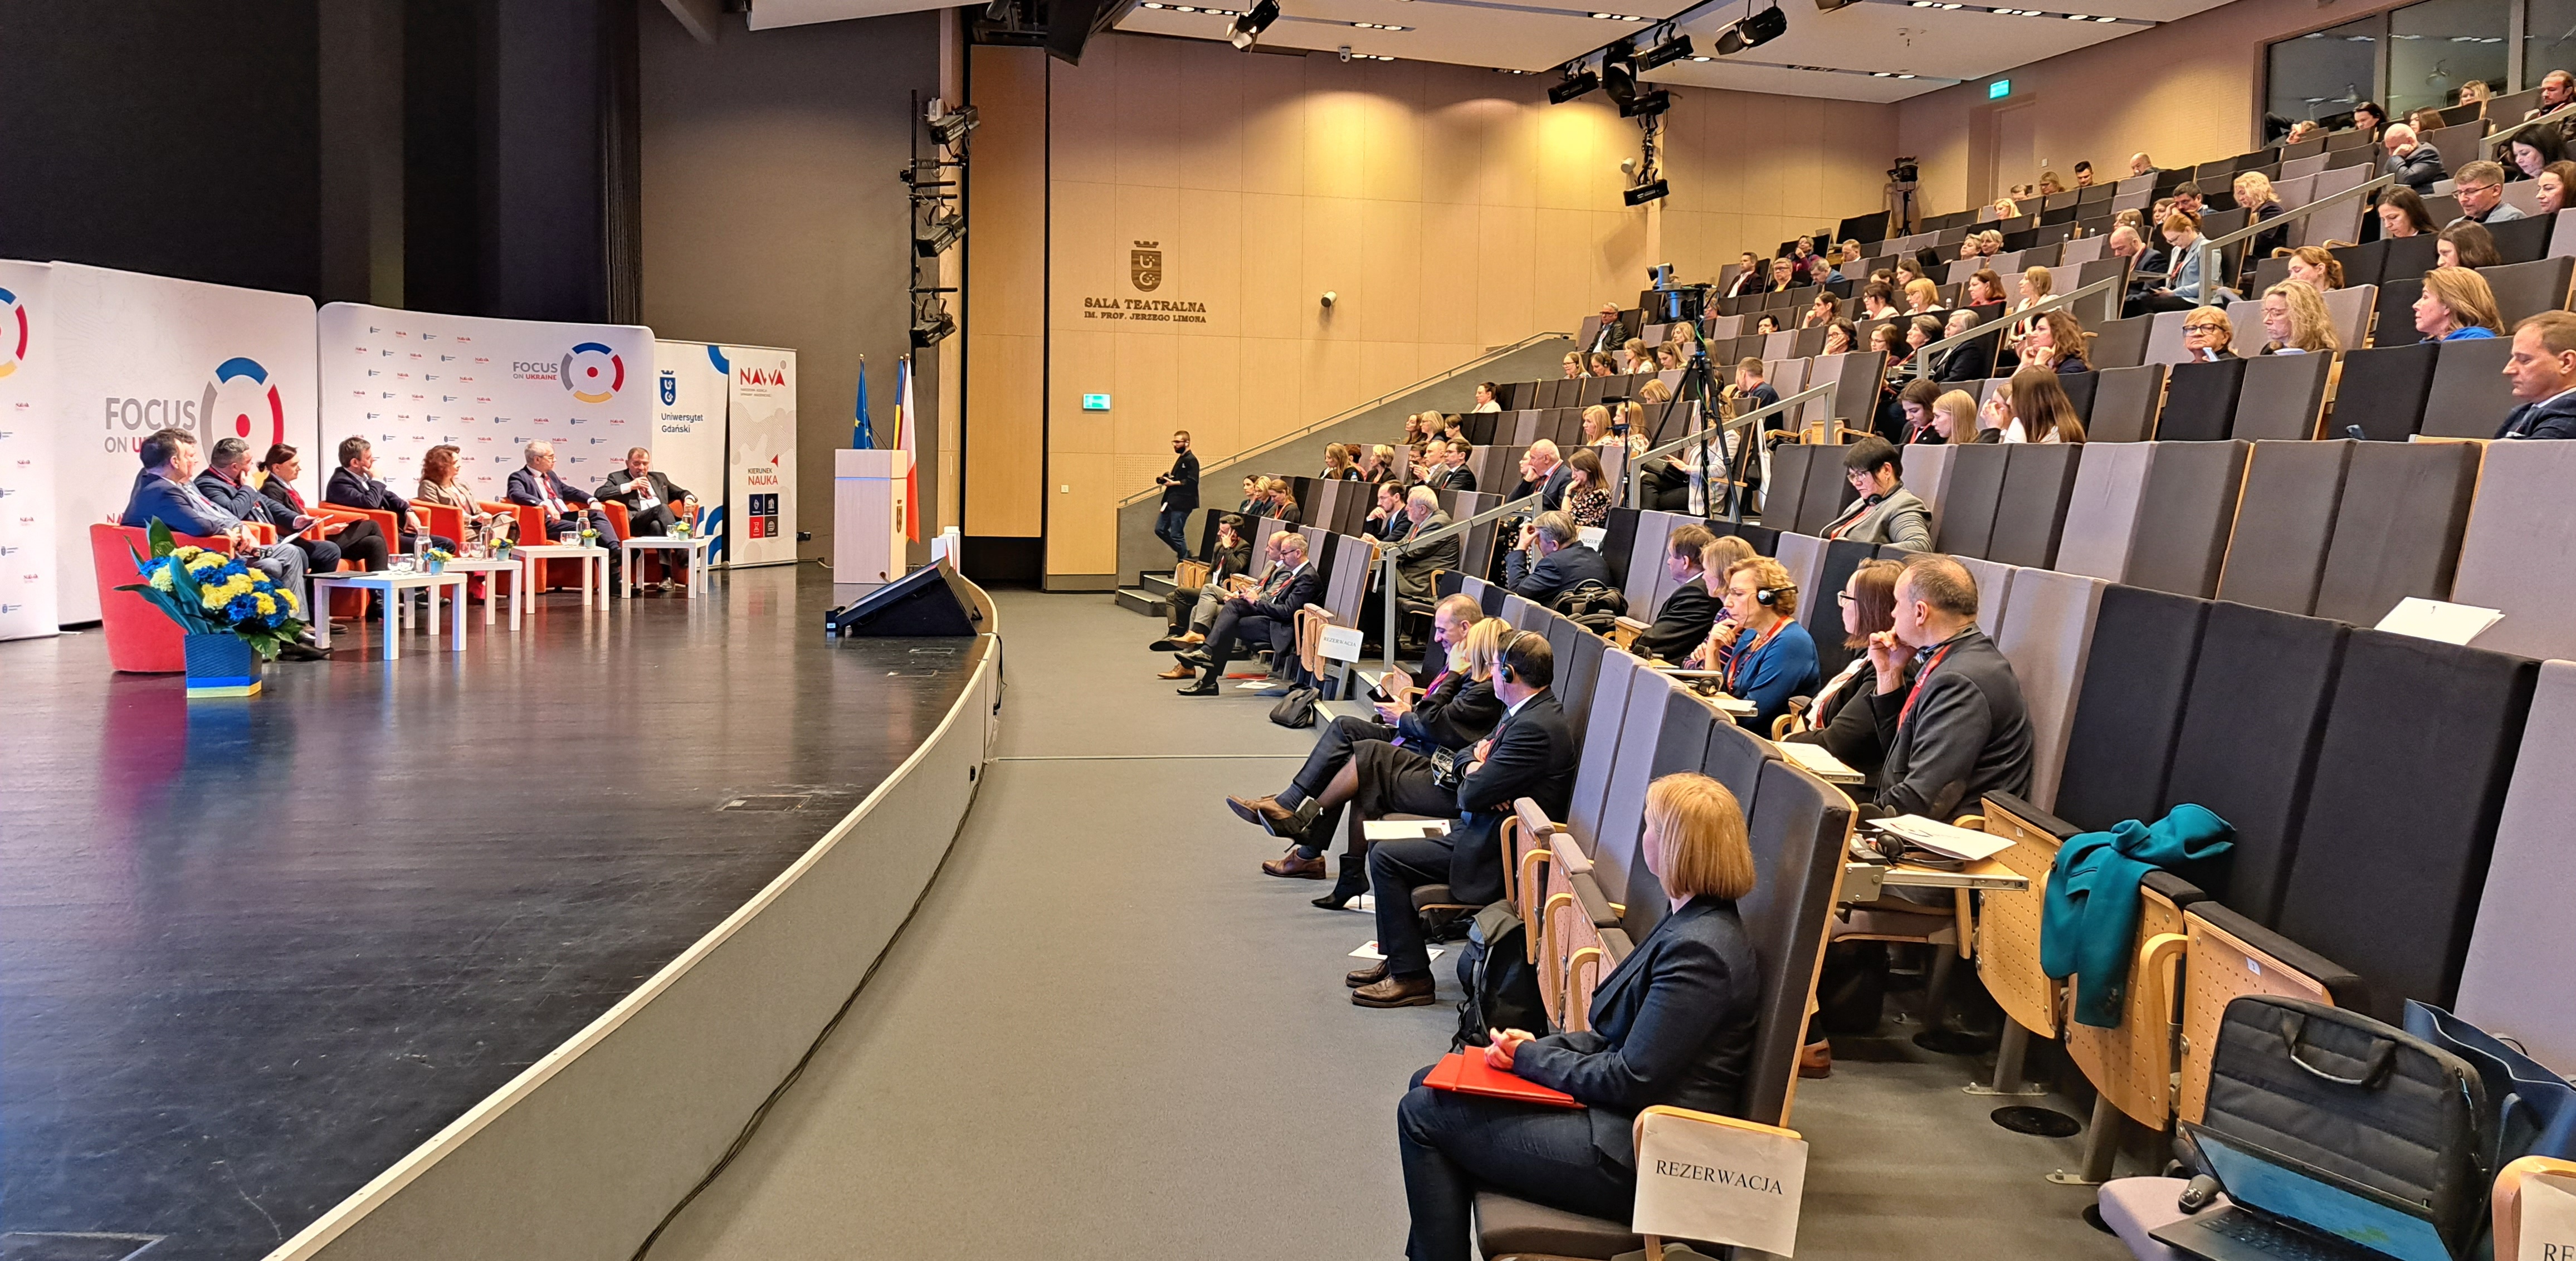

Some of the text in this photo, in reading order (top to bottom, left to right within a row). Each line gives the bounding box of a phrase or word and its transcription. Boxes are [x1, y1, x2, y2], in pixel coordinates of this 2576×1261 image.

[1084, 297, 1206, 312] SALA TEATRALNA
[1130, 313, 1170, 321] JERZEGO
[513, 361, 558, 373] FOCUS
[740, 367, 786, 387] NAWA
[106, 398, 196, 431] FOCUS
[661, 413, 703, 423] Uniwersytet
[662, 424, 690, 433] Gdański
[105, 436, 127, 453] ON
[748, 475, 778, 485] NAUKA
[1324, 636, 1357, 647] REZERWACJA
[1655, 1160, 1783, 1195] REZERWACJA
